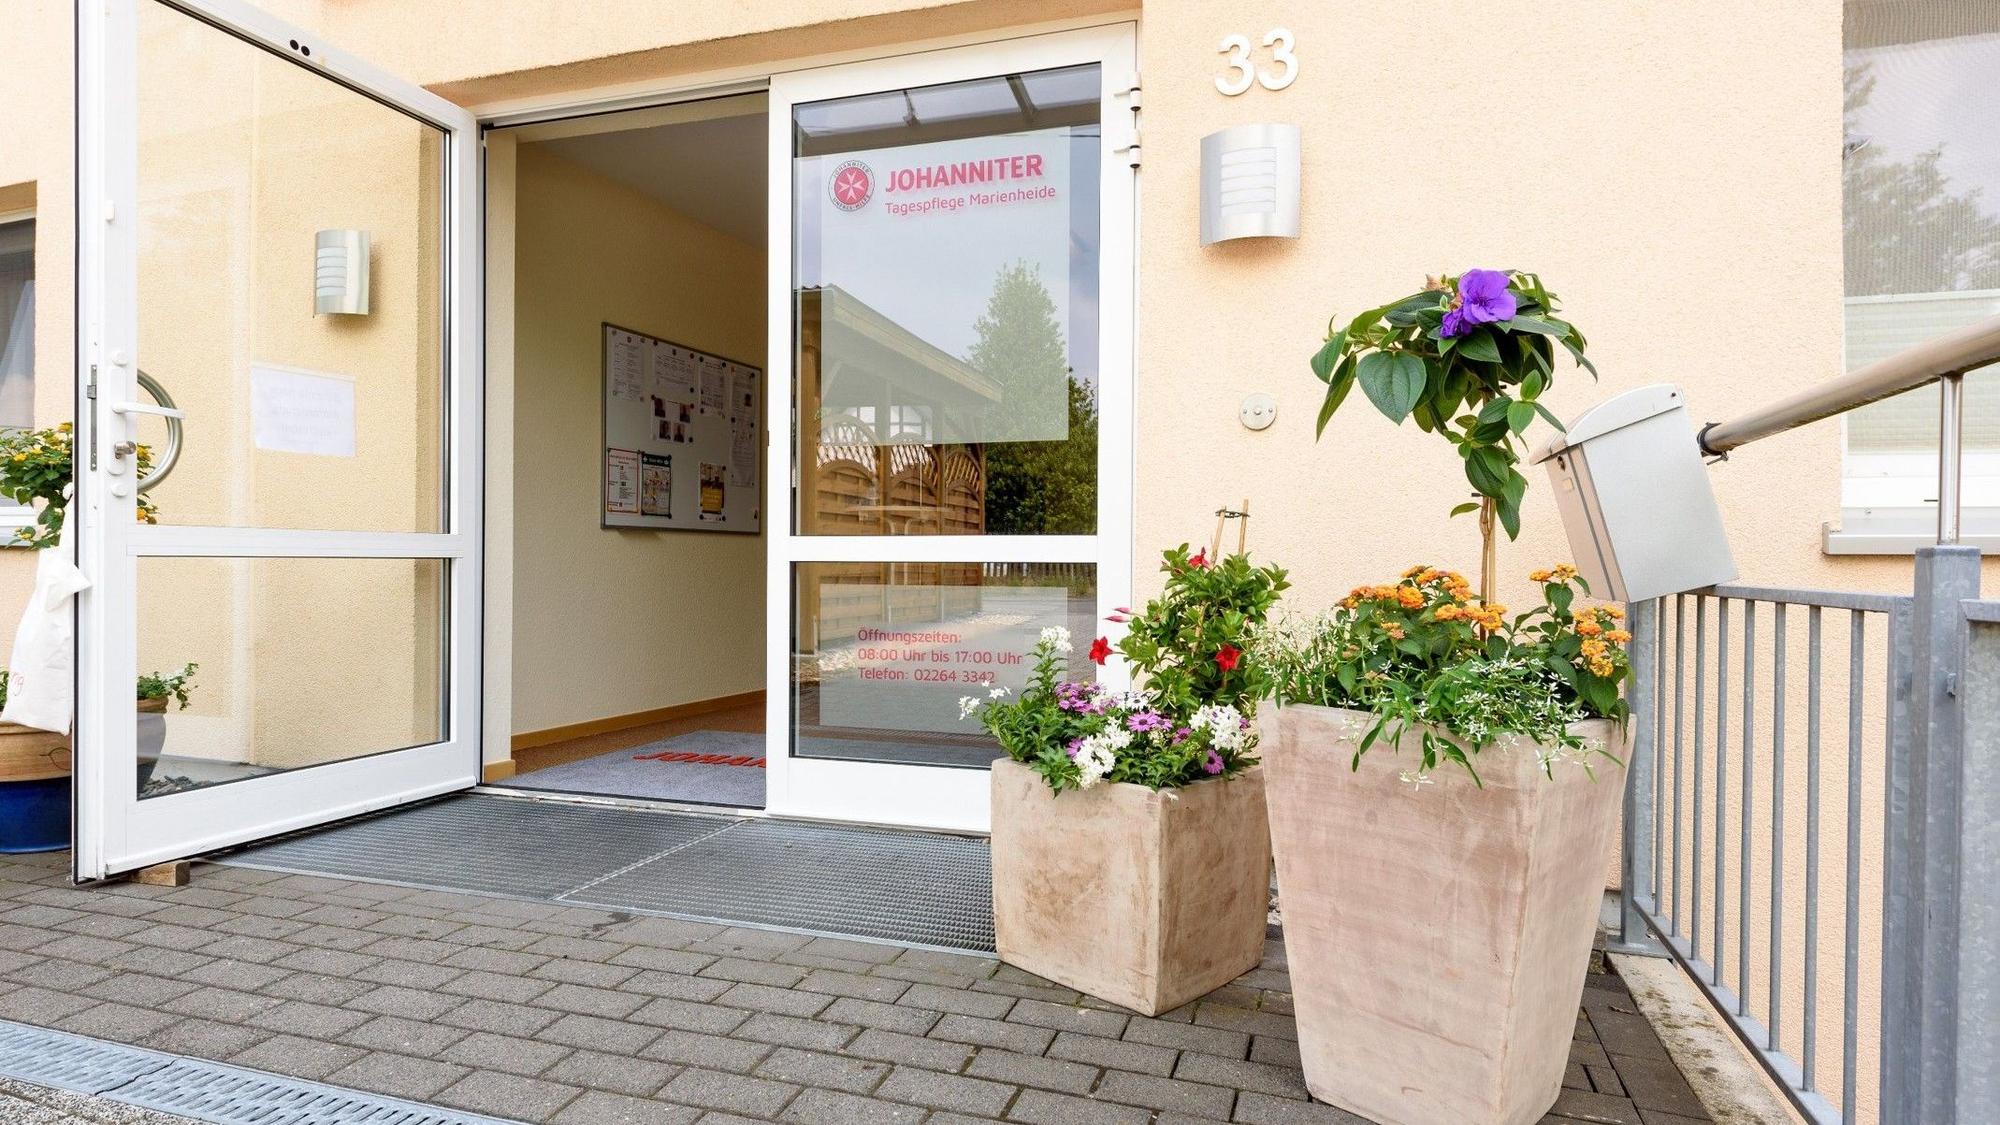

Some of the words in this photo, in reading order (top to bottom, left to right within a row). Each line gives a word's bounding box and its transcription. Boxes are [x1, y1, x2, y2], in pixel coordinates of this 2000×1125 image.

[1215, 27, 1299, 96] 33
[885, 154, 1043, 193] JOHANNITER
[885, 197, 965, 216] Tagespflege
[969, 185, 1056, 206] Marienheide
[858, 628, 962, 645] Öffnungszeiten:
[858, 648, 898, 660] 08:00
[903, 650, 926, 662] Uhr
[931, 650, 950, 663] bis
[955, 651, 992, 664] 17:00
[997, 652, 1023, 665] Uhr
[858, 667, 908, 680] Telefon:
[914, 669, 957, 682] 02264
[962, 671, 995, 684] 3342
